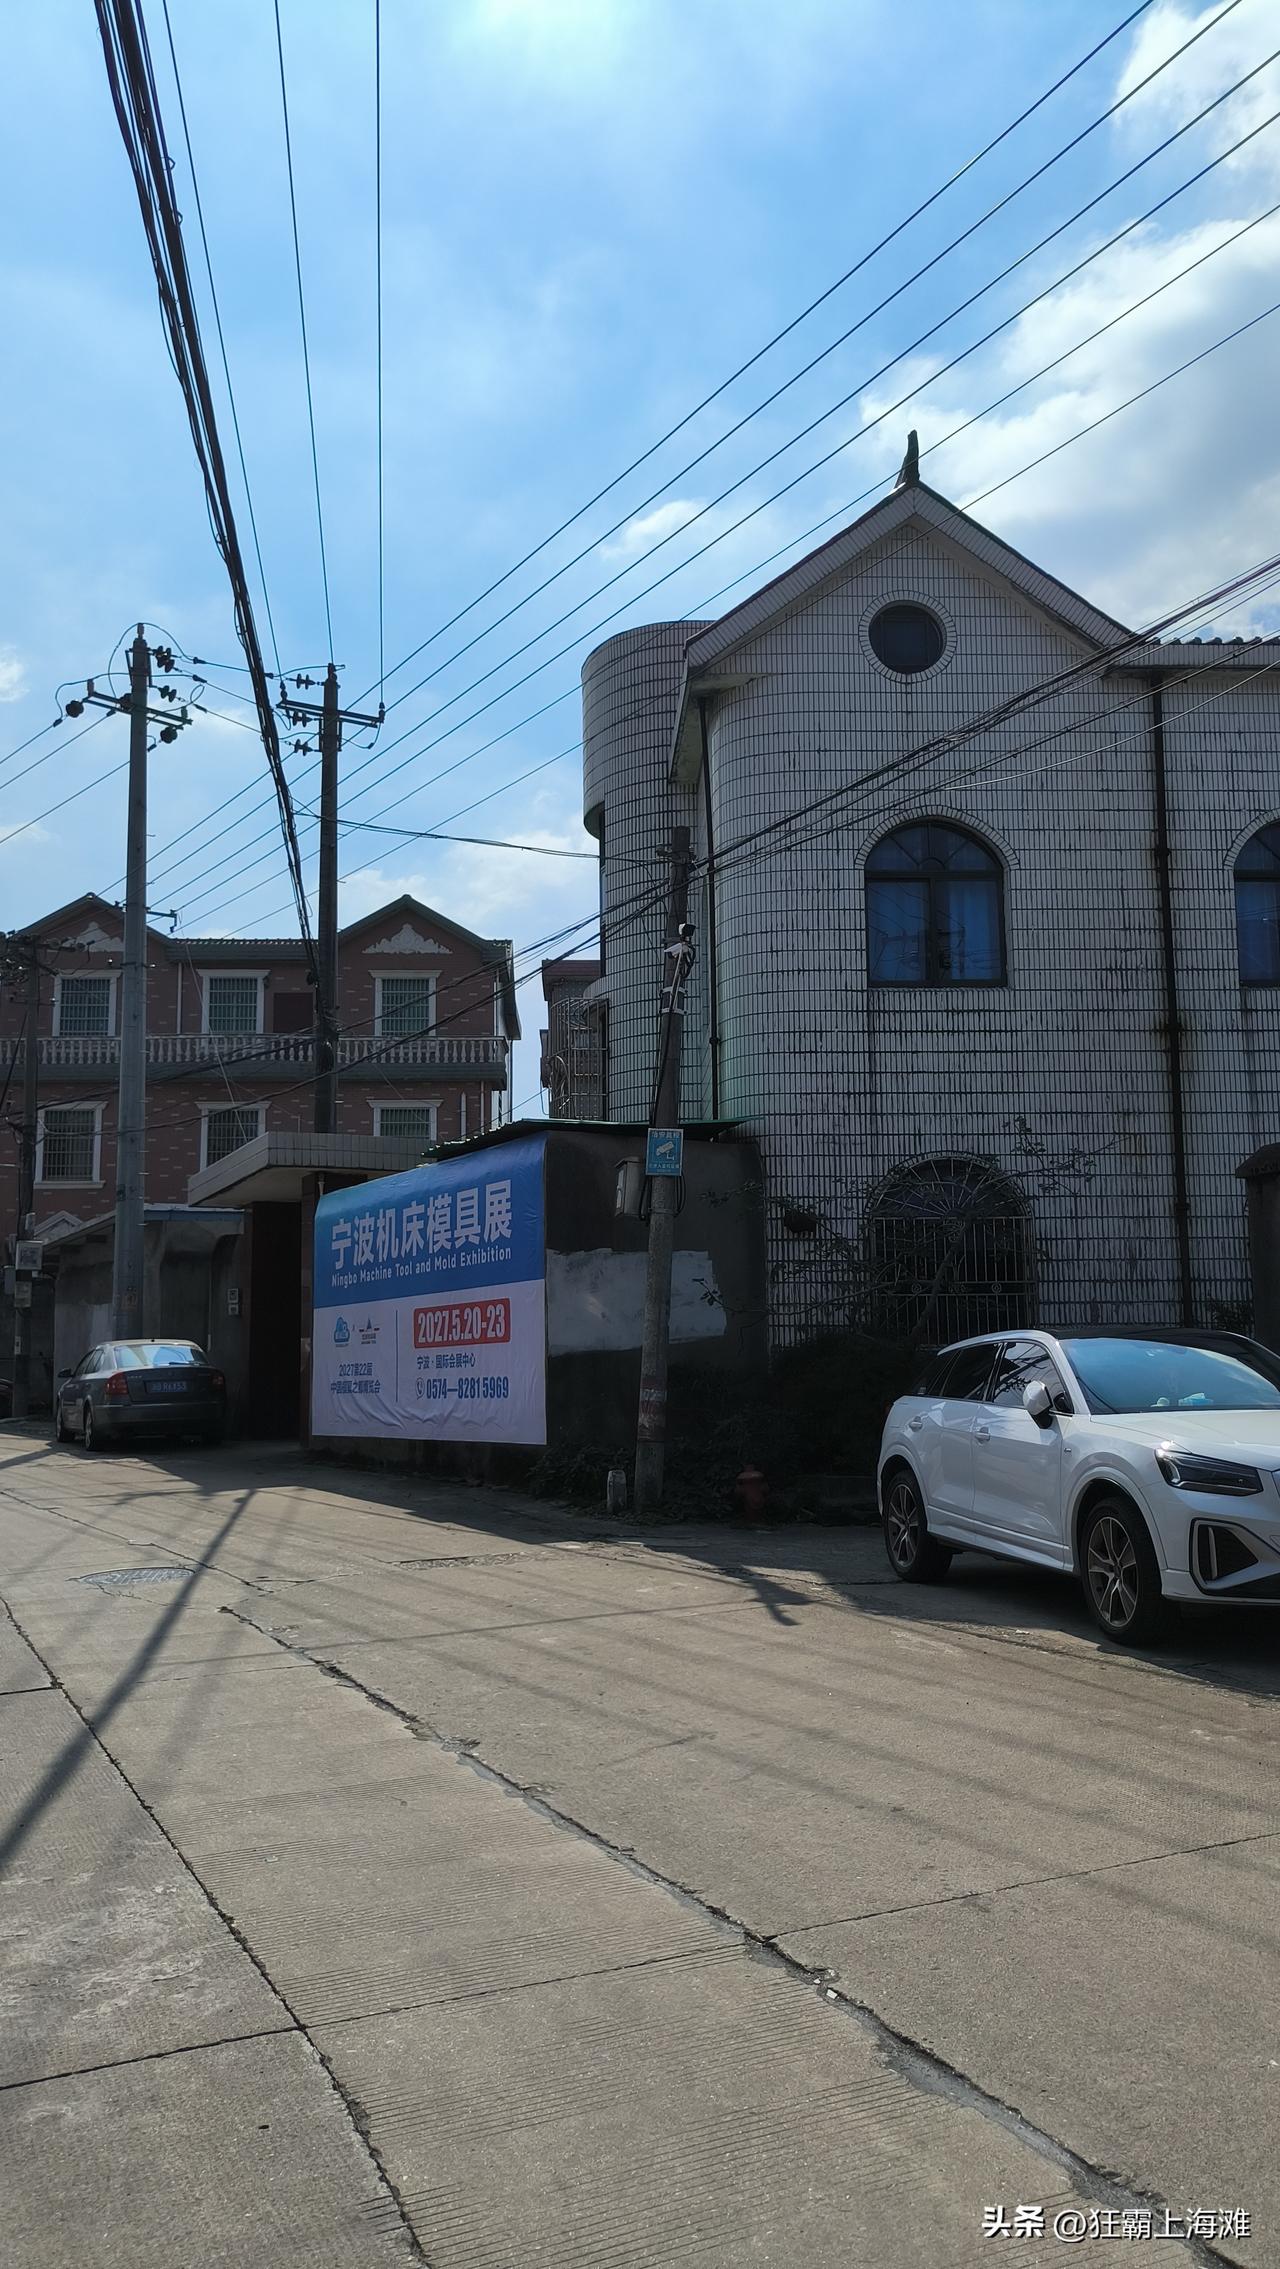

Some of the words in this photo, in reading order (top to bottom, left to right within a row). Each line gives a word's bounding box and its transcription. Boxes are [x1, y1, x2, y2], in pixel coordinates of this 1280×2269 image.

[331, 1179, 512, 1270] 宁波机床模具展
[331, 1272, 358, 1289] Ningbo
[361, 1265, 392, 1283] Machine
[395, 1261, 412, 1277] Tool
[415, 1260, 431, 1274] and
[435, 1255, 457, 1271] Mold
[460, 1246, 512, 1268] Exhibition
[417, 1303, 506, 1344] 2027.5.20-23
